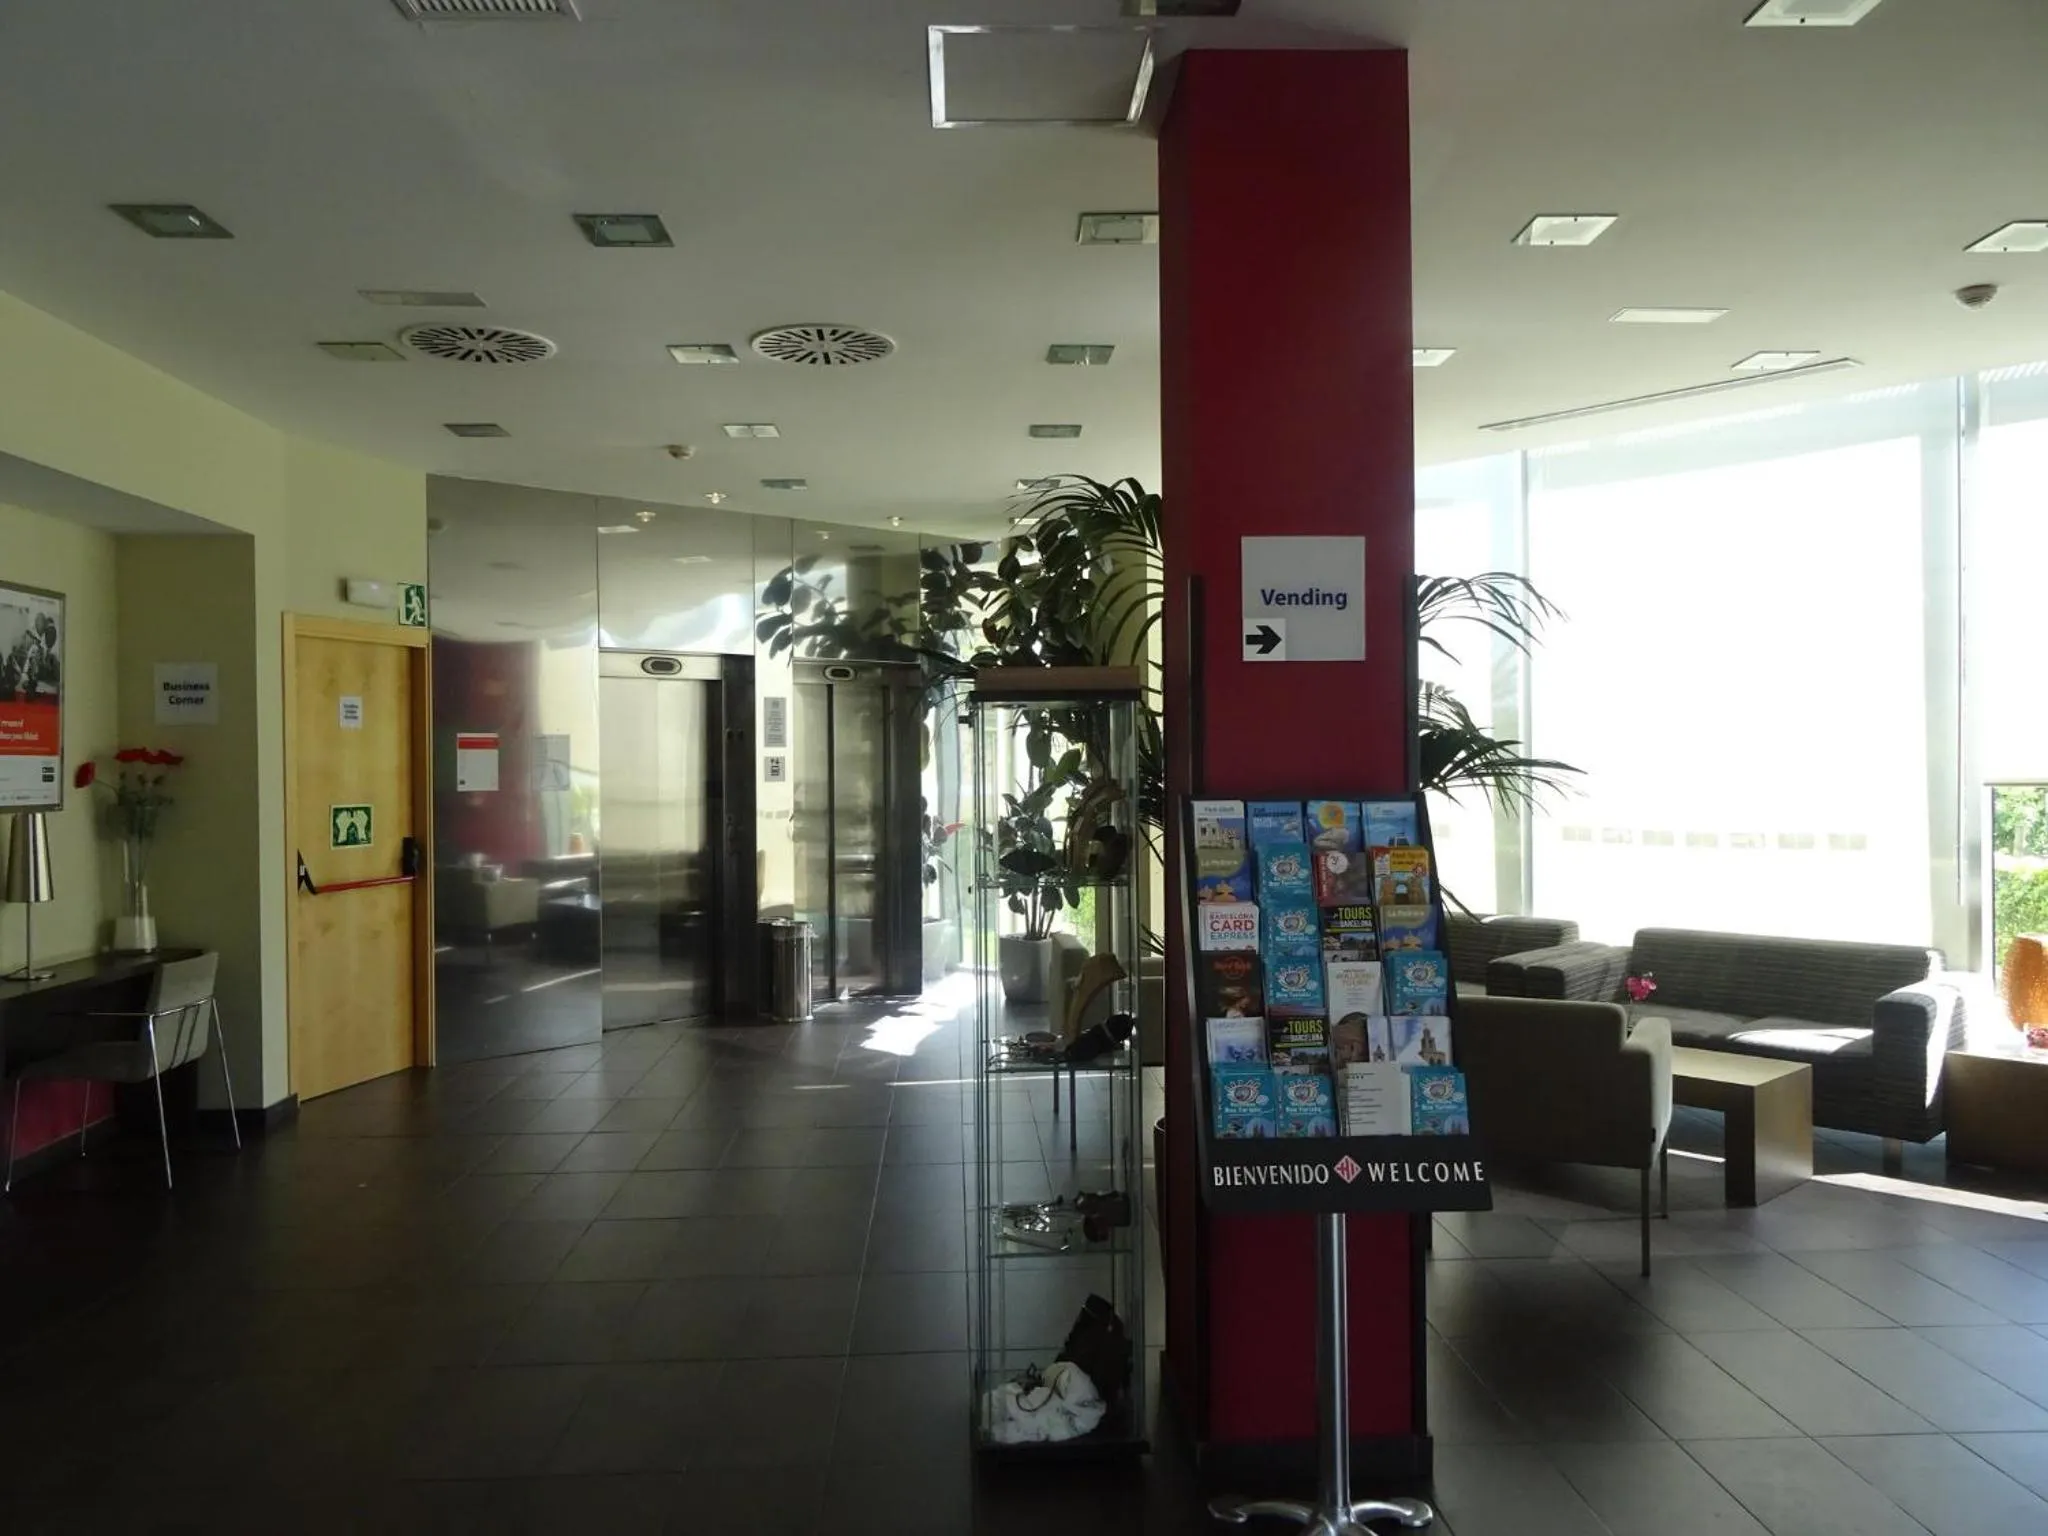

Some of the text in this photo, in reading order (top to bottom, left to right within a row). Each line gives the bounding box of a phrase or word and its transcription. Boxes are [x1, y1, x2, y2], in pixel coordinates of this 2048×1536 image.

[1260, 588, 1348, 610] Vending
[163, 681, 210, 691] Business
[168, 695, 204, 705] Corner
[1209, 912, 1254, 920] BARCELONA
[1338, 907, 1372, 920] TOURS
[1210, 919, 1255, 932] CARD
[1210, 932, 1256, 941] EXPRESS
[1288, 1019, 1323, 1034] TOURS
[1213, 1163, 1330, 1187] BIENVENIDO
[1367, 1161, 1485, 1183] WELCOME
